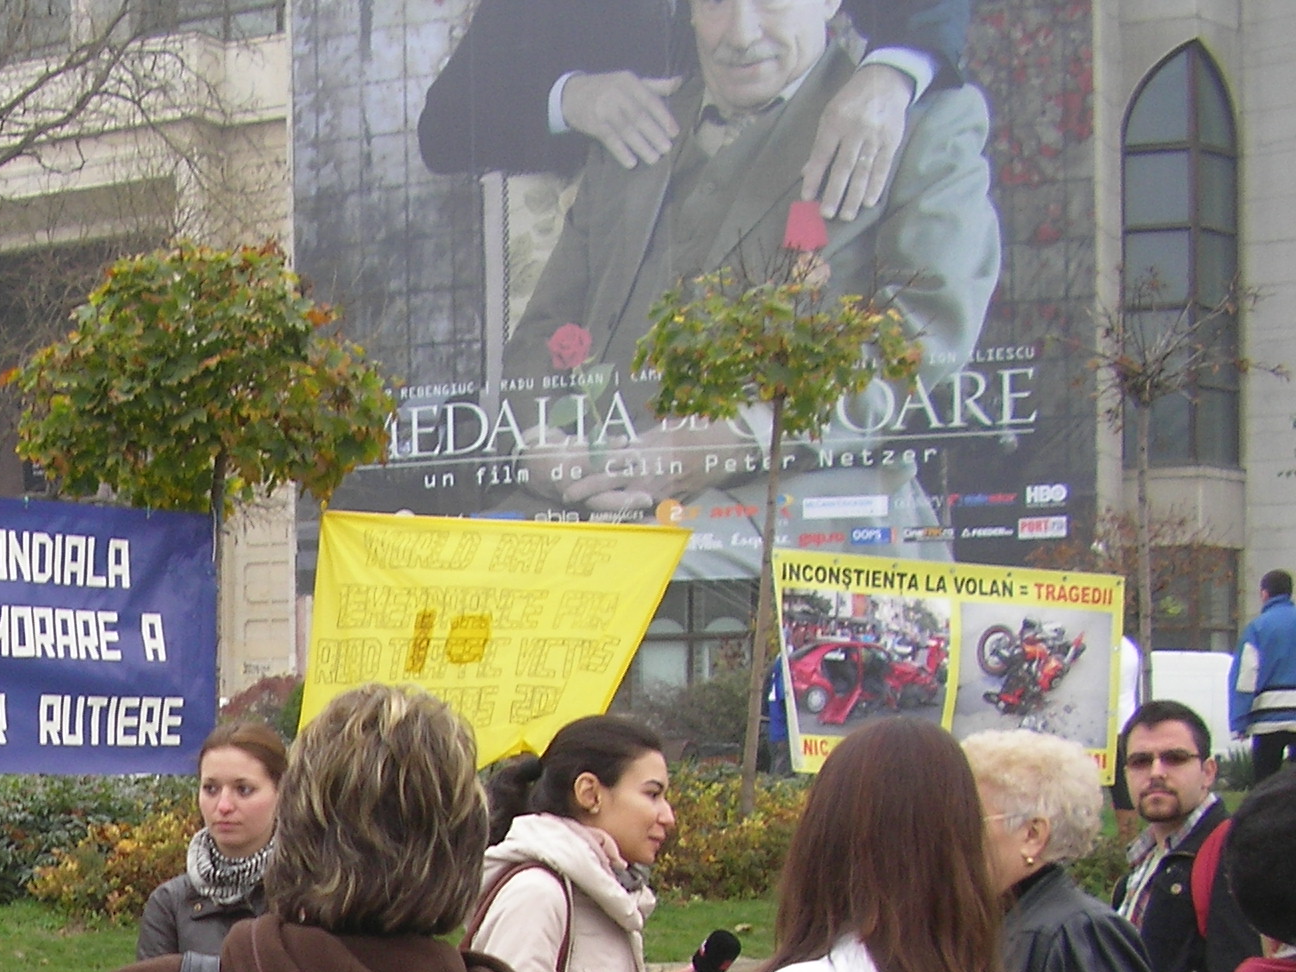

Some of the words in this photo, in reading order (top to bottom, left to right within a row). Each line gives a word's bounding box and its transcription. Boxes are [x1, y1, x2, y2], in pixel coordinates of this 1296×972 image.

[501, 377, 534, 391] RADU
[424, 472, 455, 488] un
[477, 466, 530, 486] film
[551, 463, 583, 480] de
[705, 453, 796, 474] Peter
[819, 446, 938, 469] Netzer
[1026, 484, 1068, 504] HBO
[925, 574, 948, 594] LA
[954, 577, 1014, 598] VOLAN
[1034, 582, 1113, 606] TRAGEDII
[141, 612, 167, 662] A
[39, 693, 185, 747] RUTIERE
